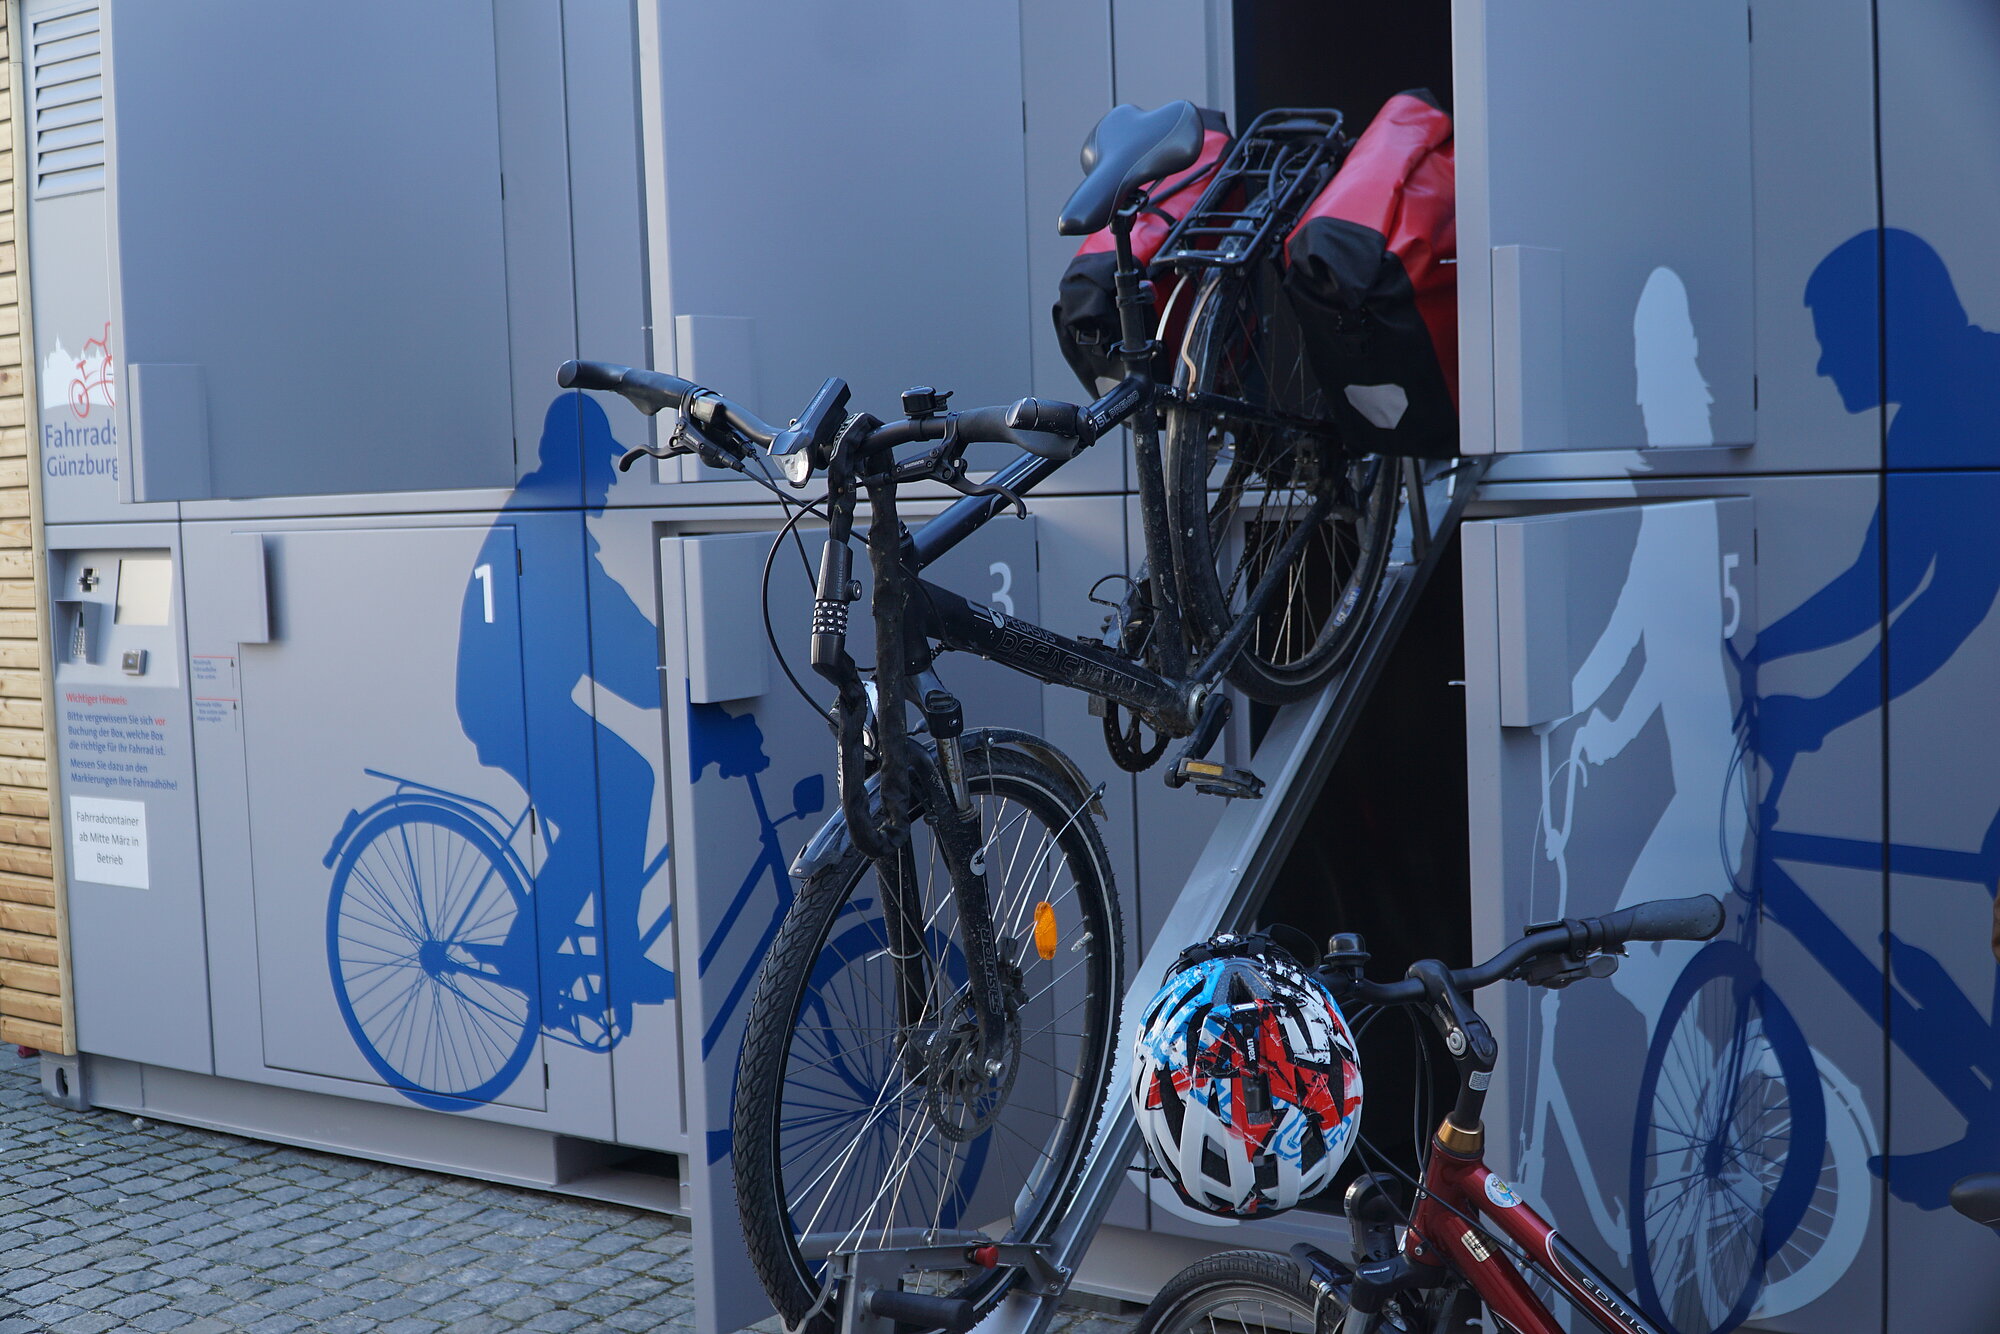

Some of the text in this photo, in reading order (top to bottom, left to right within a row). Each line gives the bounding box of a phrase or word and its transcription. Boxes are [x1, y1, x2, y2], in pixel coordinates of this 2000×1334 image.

[47, 453, 118, 481] Günzburg
[474, 563, 494, 623] 1
[989, 562, 1014, 617] 3
[1723, 553, 1740, 640] 5
[1005, 616, 1056, 643] PEGASUS
[66, 693, 97, 706] Wichtiger
[67, 711, 166, 726] Bitte vergewissern Sie sich vor
[68, 726, 97, 739] Buchung
[98, 728, 109, 738] der
[126, 729, 150, 740] welche
[151, 731, 163, 741] Box
[69, 741, 79, 750] die
[81, 741, 106, 754] richtige
[107, 742, 117, 752] für
[118, 743, 127, 753] Ihr
[129, 744, 154, 755] Fahrrad
[70, 758, 148, 773] Messen Sie dazu an den
[71, 773, 118, 788] Markierungen
[118, 776, 132, 786] Ihre
[76, 811, 140, 826] Fahrradcontainer
[79, 832, 139, 847] ab Mitte März in
[97, 852, 123, 865] Betrieb
[1246, 1038, 1256, 1061] uvex
